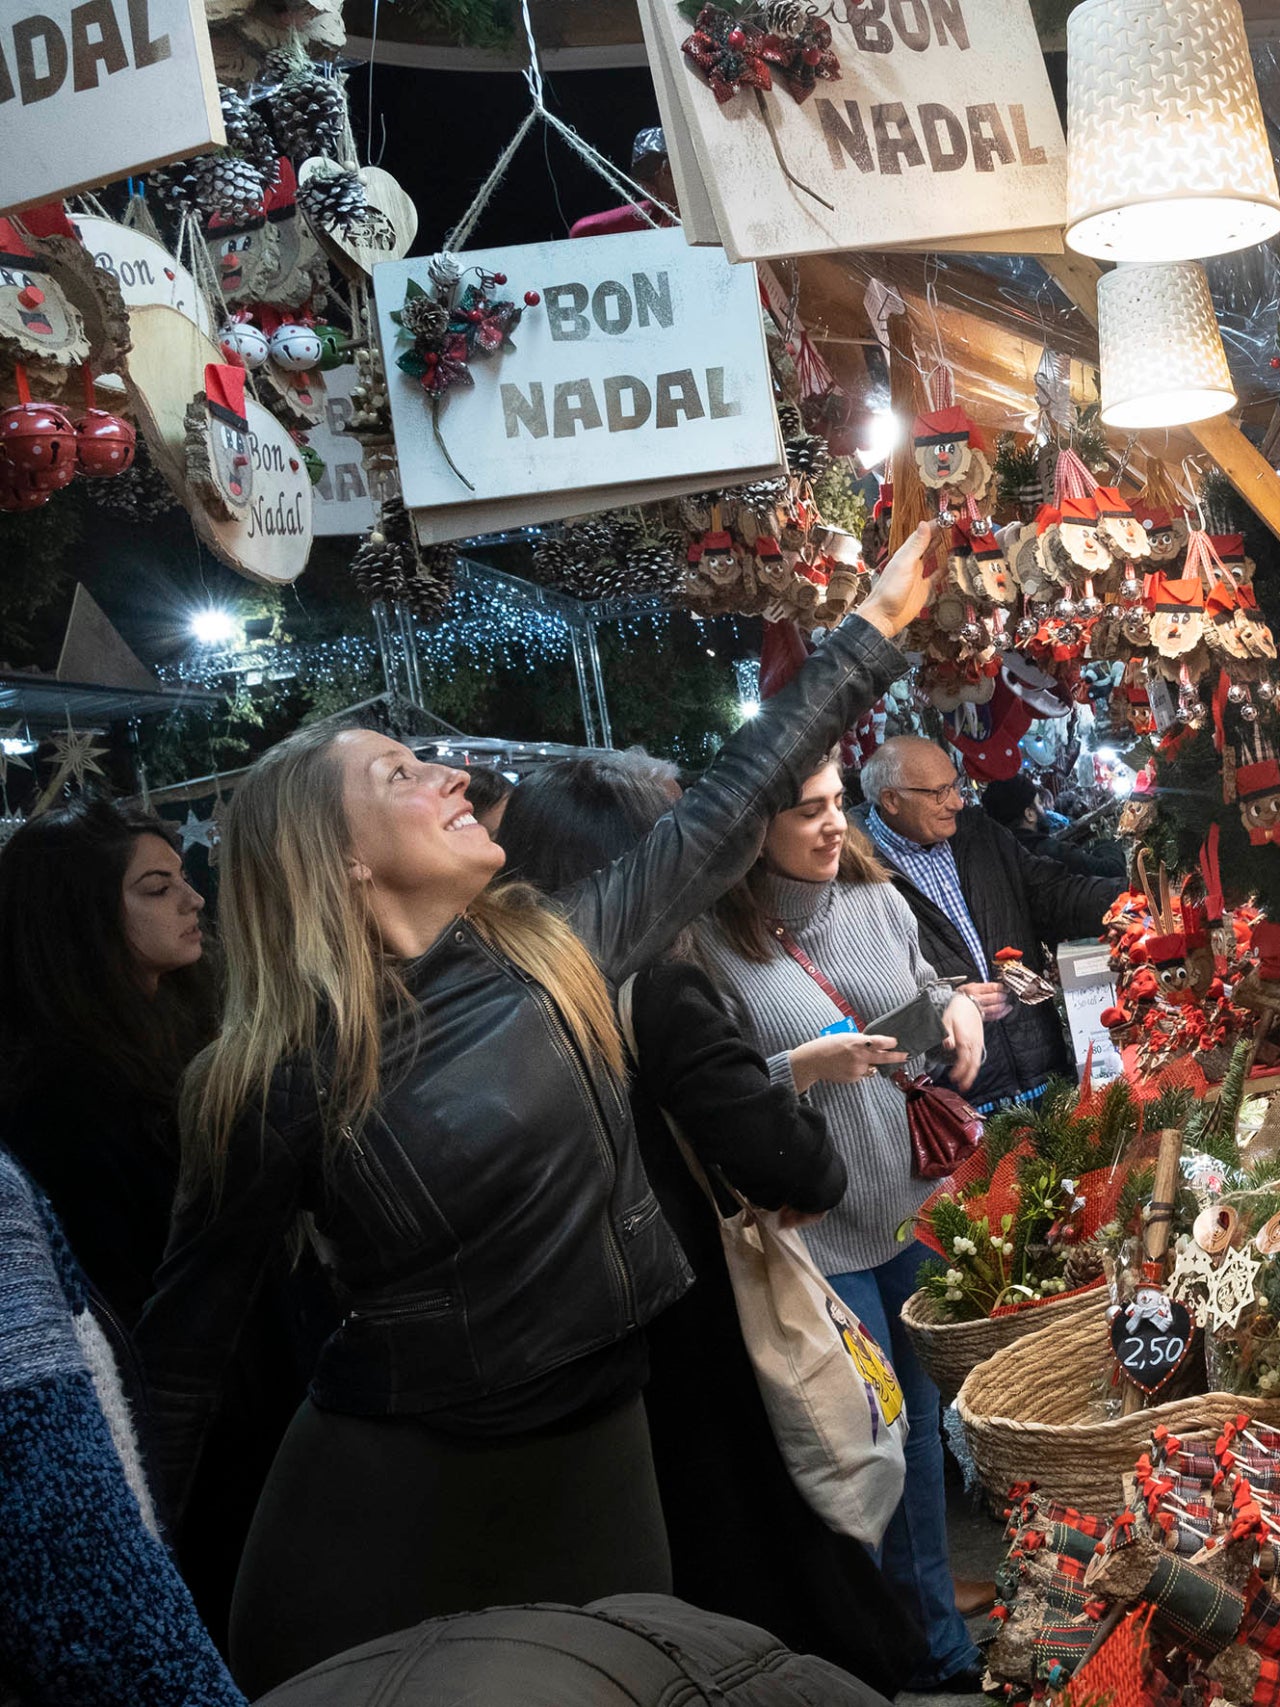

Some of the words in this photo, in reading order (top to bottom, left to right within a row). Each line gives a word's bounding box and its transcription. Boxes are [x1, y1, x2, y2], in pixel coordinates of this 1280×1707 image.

[0, 0, 171, 106] DAL
[814, 98, 1048, 175] NADAL
[542, 271, 674, 342] BON
[500, 367, 742, 439] NADAL
[249, 432, 285, 472] Bon
[247, 491, 304, 538] Nadal
[1124, 1337, 1184, 1370] 2,50
